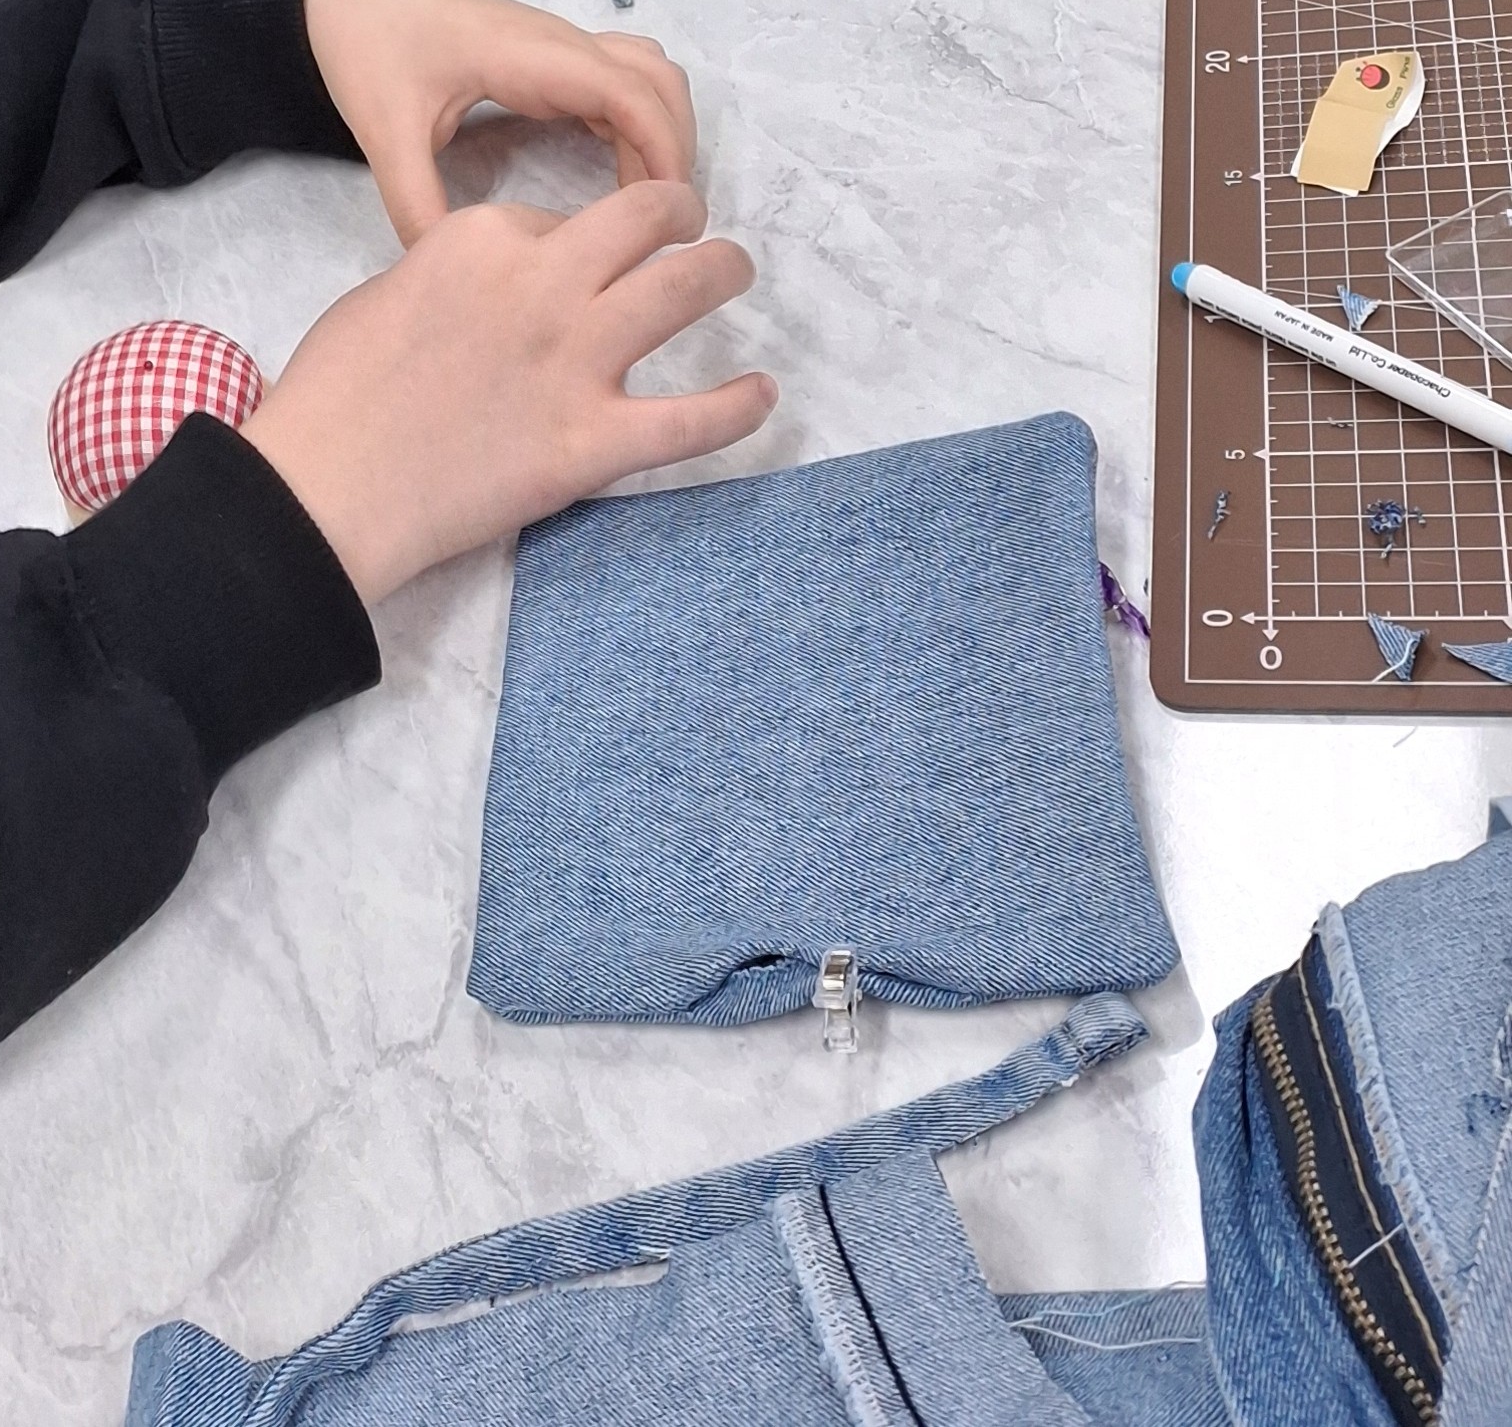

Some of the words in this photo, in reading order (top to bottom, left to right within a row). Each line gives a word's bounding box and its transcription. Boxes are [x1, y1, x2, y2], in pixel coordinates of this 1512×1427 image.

[1205, 50, 1231, 74] 20
[1224, 170, 1243, 187] 15
[1274, 310, 1301, 326] JAPAN
[1300, 321, 1310, 331] IN
[1311, 328, 1335, 342] MADE
[1387, 363, 1451, 398] Chacopaper
[1225, 449, 1246, 460] 5
[1202, 609, 1234, 627] 0
[1259, 645, 1283, 670] 0
